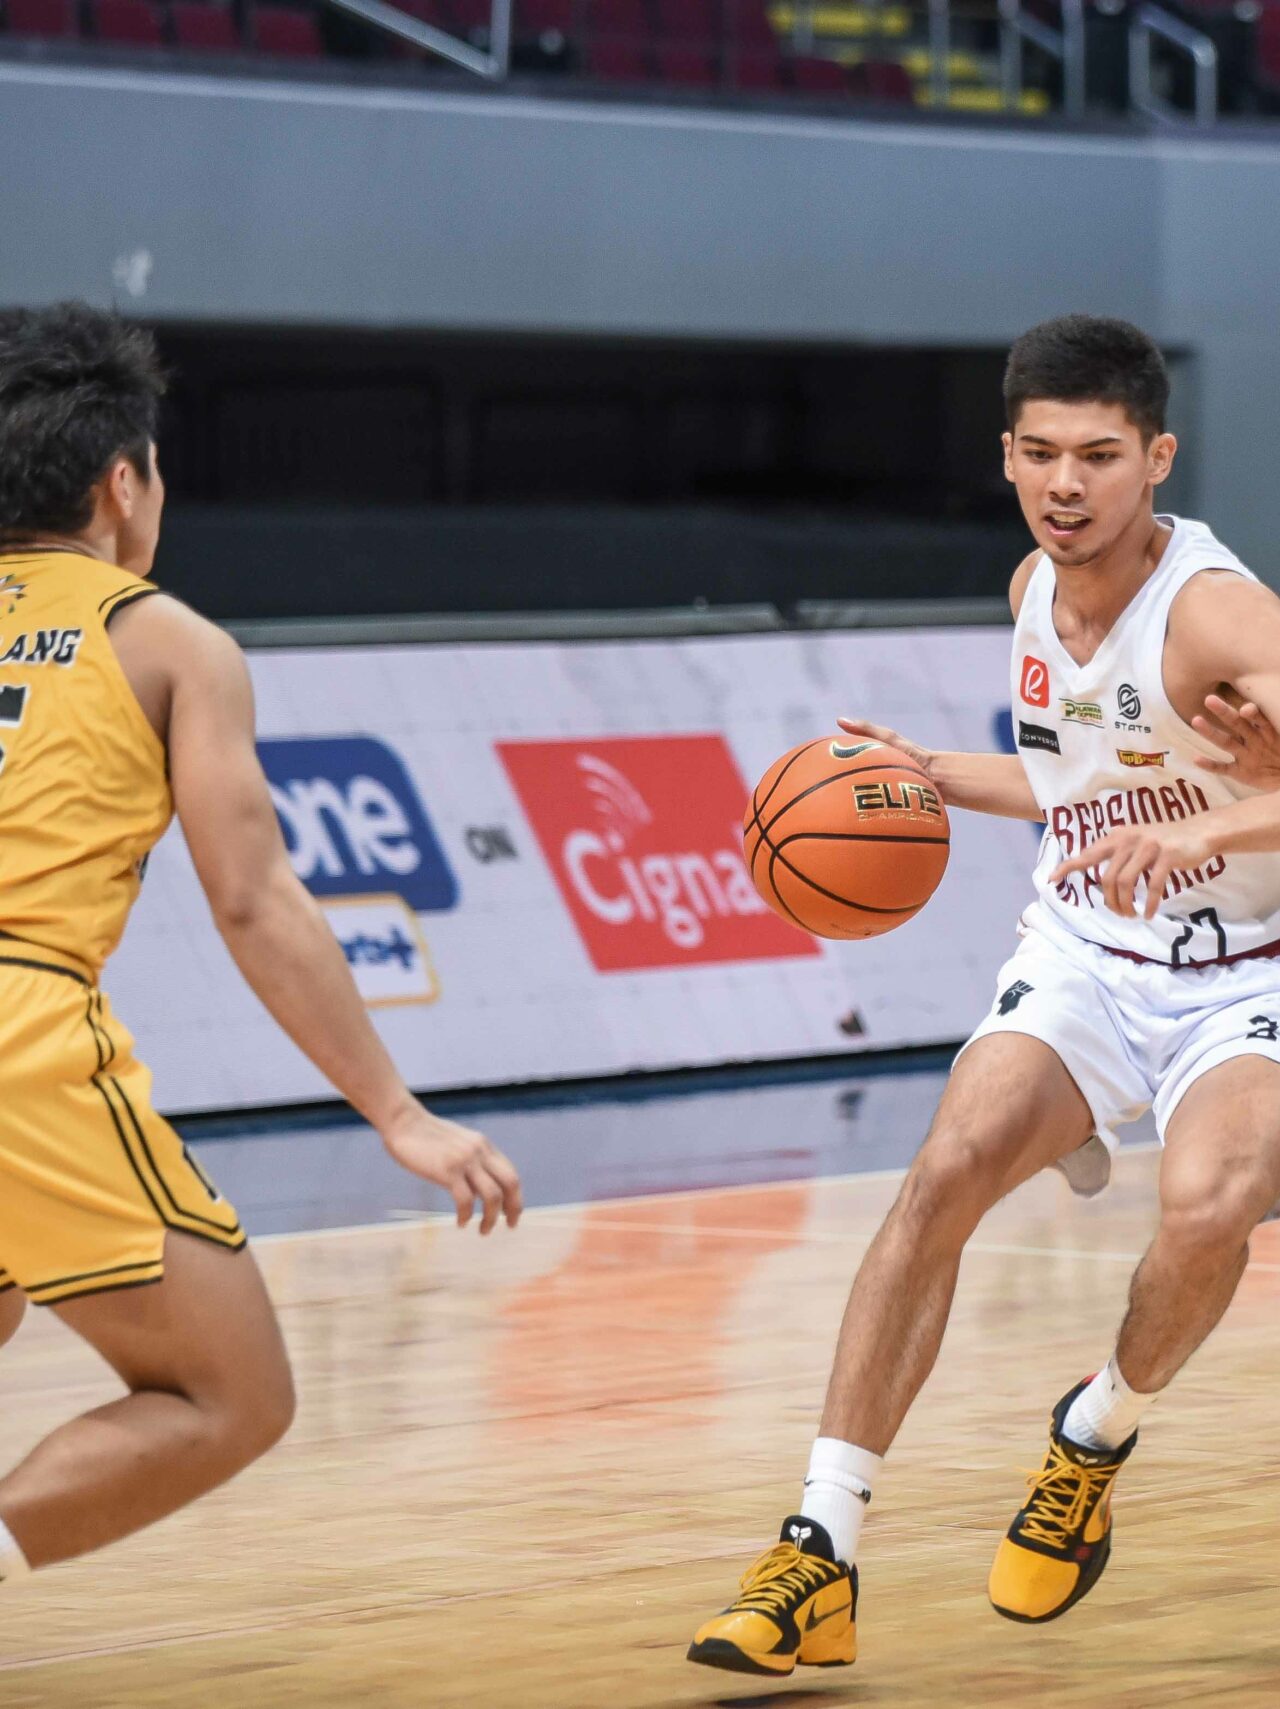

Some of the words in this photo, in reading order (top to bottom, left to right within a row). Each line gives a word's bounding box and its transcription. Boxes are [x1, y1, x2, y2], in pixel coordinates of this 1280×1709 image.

[0, 629, 82, 667] ANG
[1021, 732, 1059, 749] CONVERSE
[1114, 721, 1152, 734] STATS
[852, 782, 942, 816] ELITE
[1042, 778, 1210, 856] BERSIDAD
[562, 822, 768, 948] Cigna
